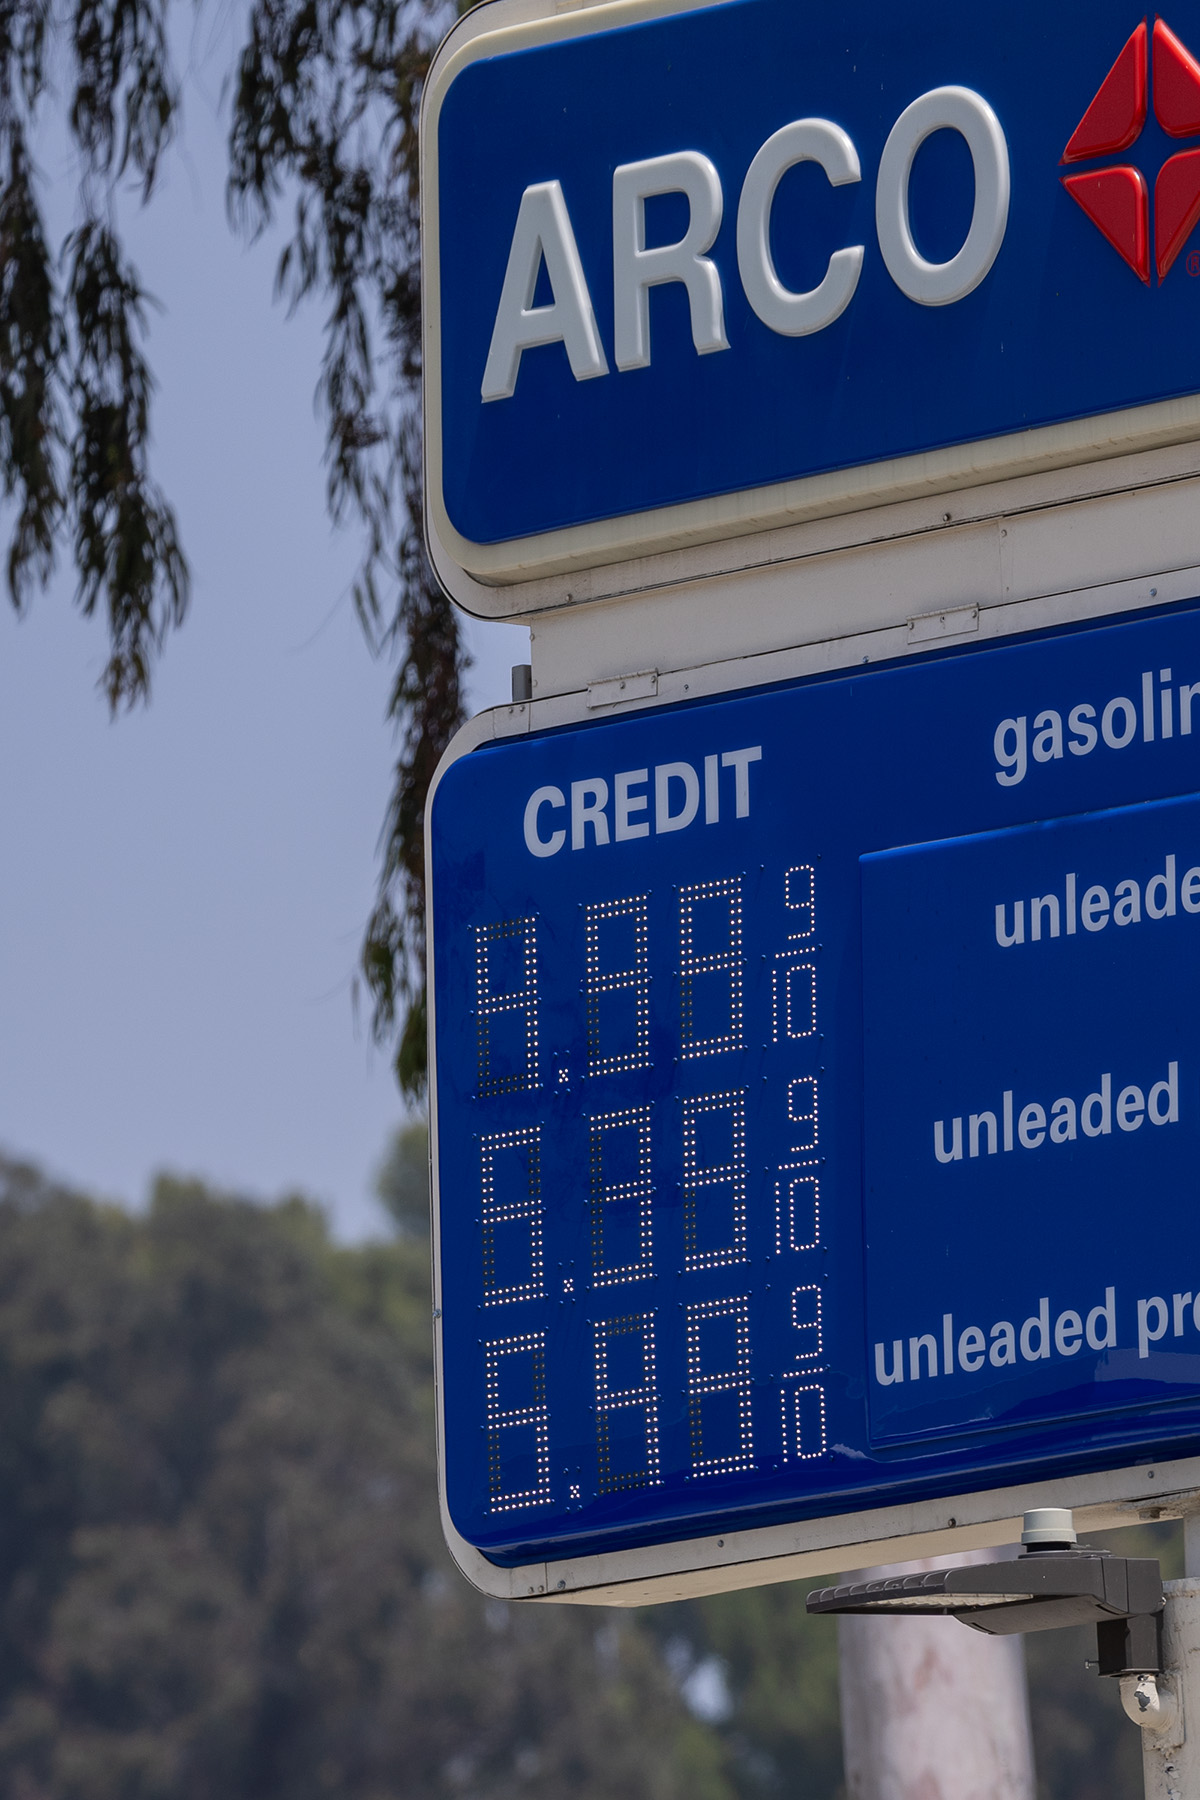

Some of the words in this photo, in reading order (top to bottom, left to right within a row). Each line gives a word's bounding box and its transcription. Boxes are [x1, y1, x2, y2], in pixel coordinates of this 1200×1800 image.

[481, 86, 1010, 403] ARCO
[524, 746, 761, 857] CREDIT
[477, 878, 742, 1088] 4.99
[482, 1091, 746, 1306] 5.39
[935, 1062, 1178, 1163] unleaded
[487, 1297, 753, 1511] 5.49
[875, 1287, 1116, 1385] unleaded
